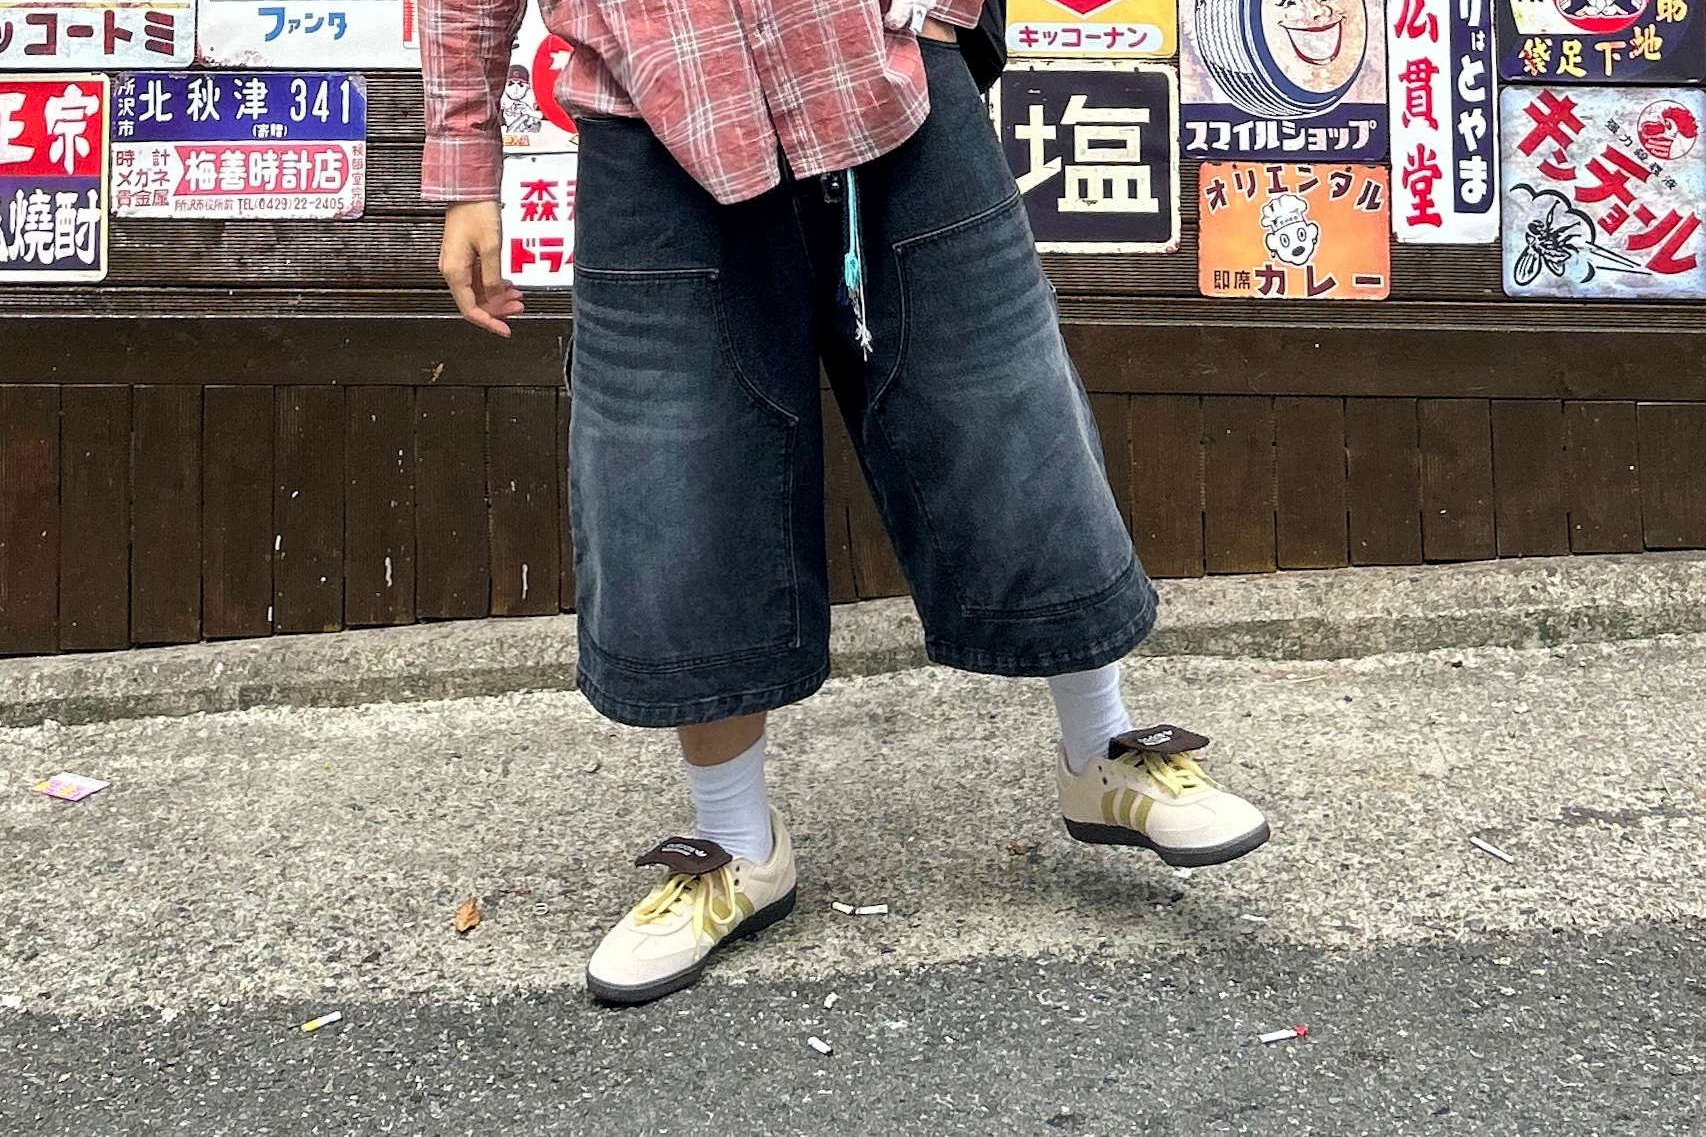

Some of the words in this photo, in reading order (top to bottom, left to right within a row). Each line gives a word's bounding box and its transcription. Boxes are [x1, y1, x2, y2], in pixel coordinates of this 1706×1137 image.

[258, 7, 347, 42] ファンタ
[1018, 27, 1150, 48] キッコーナン
[117, 77, 136, 137] 所沢市
[139, 77, 268, 122] 北秋津
[290, 78, 350, 124] 341
[1014, 94, 1159, 213] 塩
[1185, 119, 1377, 152] スマイルショップ
[116, 148, 171, 168] 時計
[185, 148, 344, 192] 梅善時計店
[520, 179, 576, 222] 森
[1206, 165, 1382, 211] オリエンタル
[1517, 88, 1702, 274] キンチョール
[511, 238, 574, 274] ドラ
[1214, 270, 1251, 290] 即席
[1255, 264, 1381, 297] カレー
